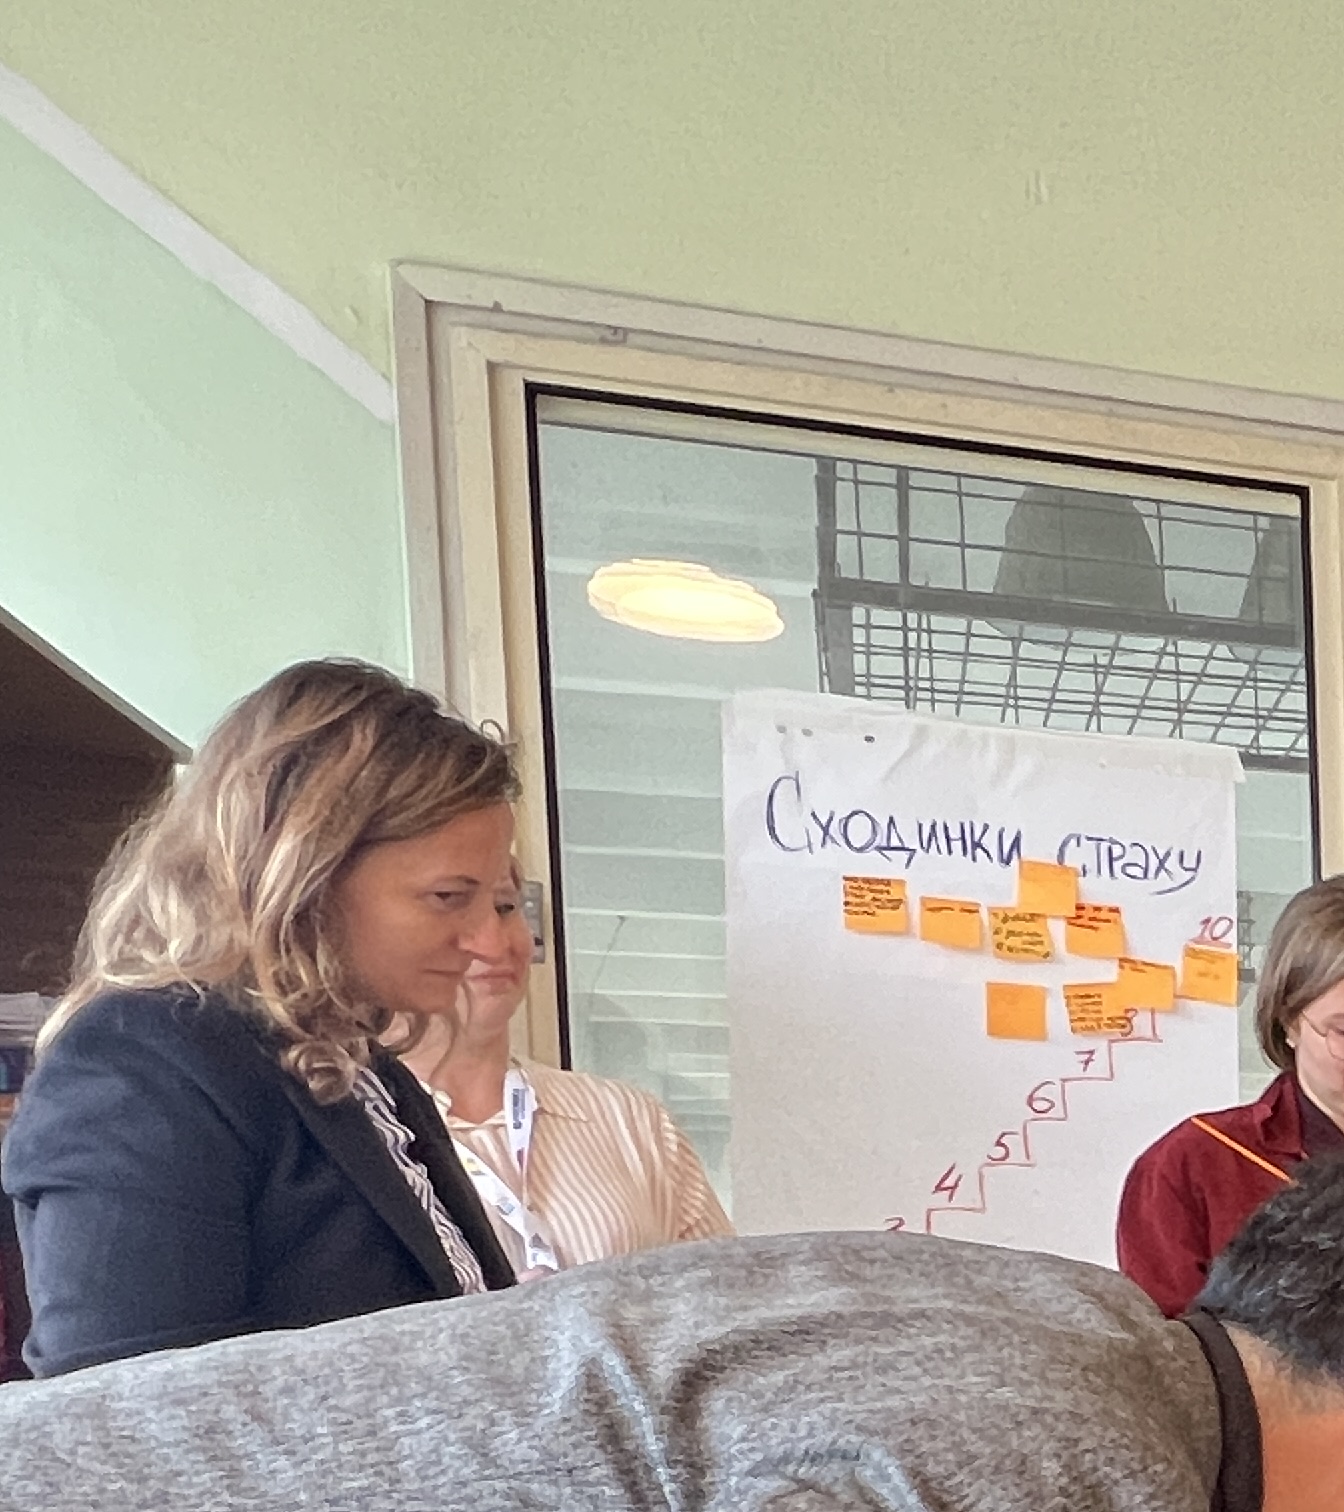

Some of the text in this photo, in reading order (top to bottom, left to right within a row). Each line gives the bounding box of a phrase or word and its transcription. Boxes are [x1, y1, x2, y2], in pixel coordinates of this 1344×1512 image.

[766, 770, 1202, 895] Сходинки страху
[1199, 916, 1234, 941] 10
[1074, 1049, 1096, 1072] 7
[1026, 1080, 1056, 1114] 6
[986, 1130, 1019, 1162] 5
[931, 1162, 964, 1203] 4
